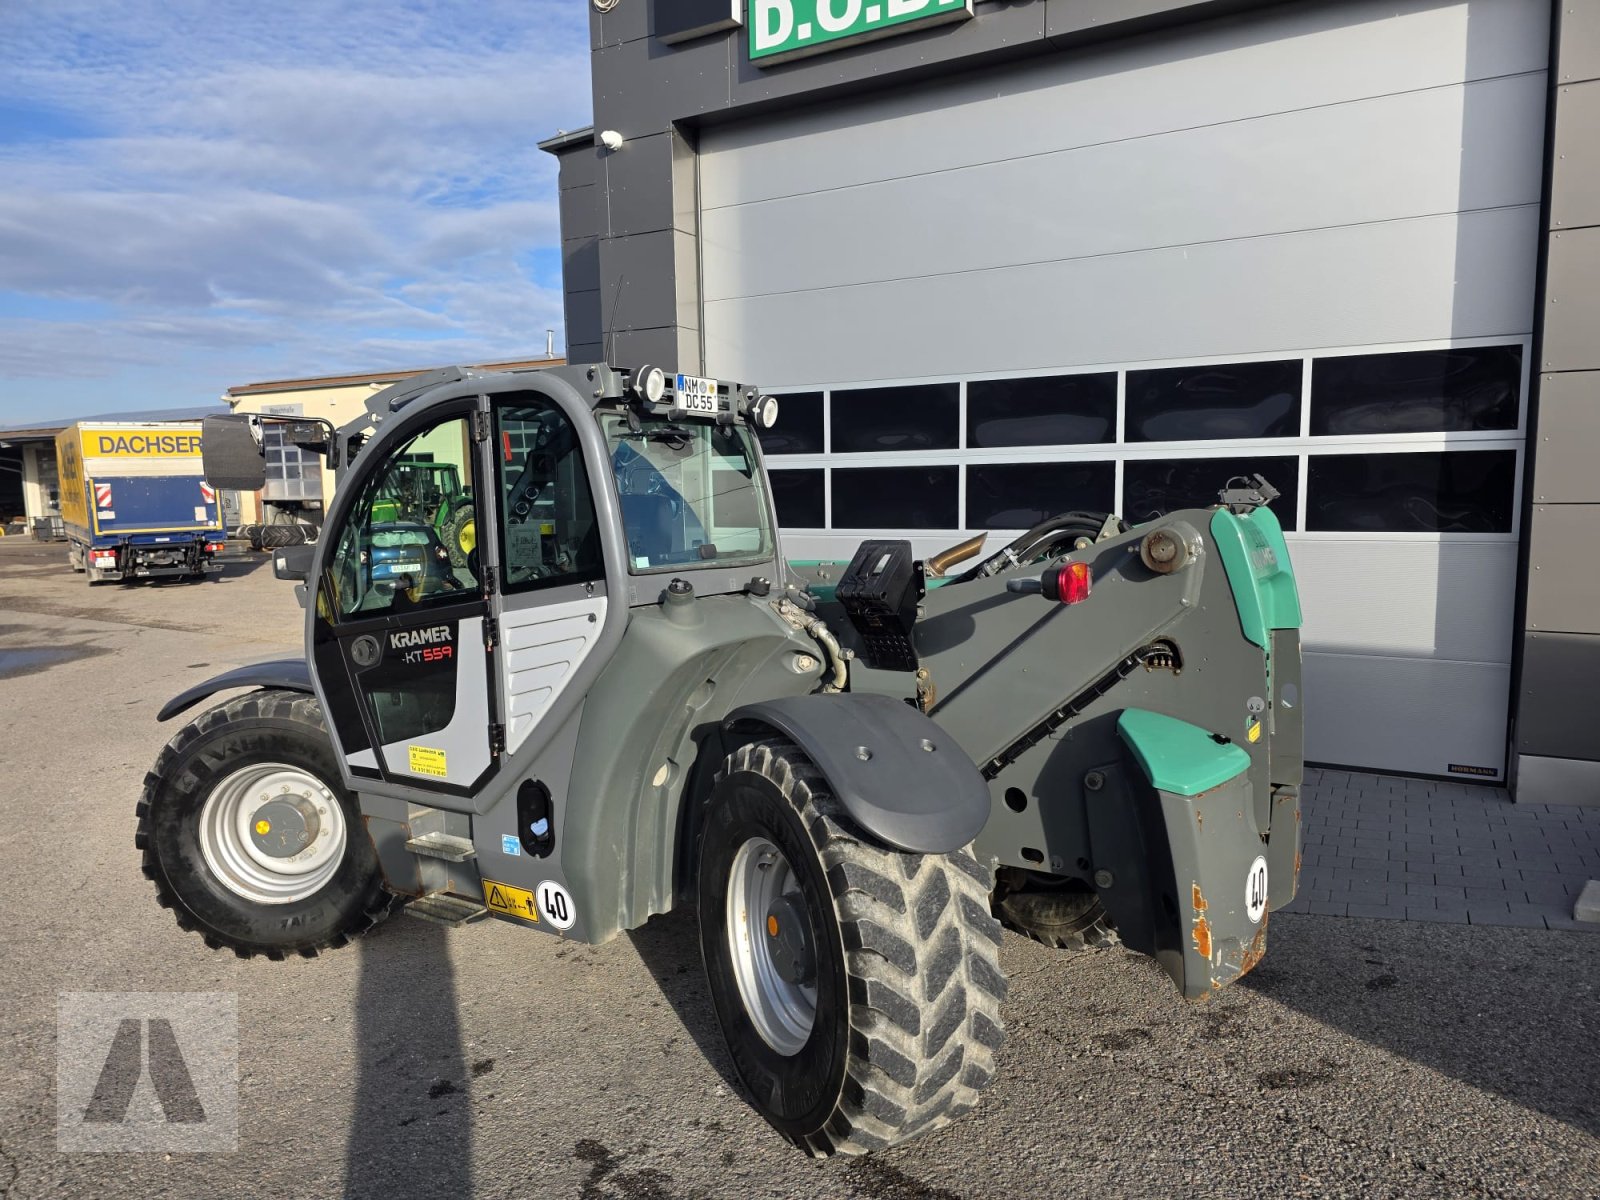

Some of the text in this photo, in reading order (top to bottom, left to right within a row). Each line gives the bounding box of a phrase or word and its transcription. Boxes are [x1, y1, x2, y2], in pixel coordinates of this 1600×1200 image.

[684, 378, 698, 393] NM
[686, 394, 713, 410] DC 55
[99, 435, 203, 454] DACHSER
[390, 626, 453, 649] KRAMER
[1251, 867, 1264, 910] 40
[544, 888, 569, 922] 40
